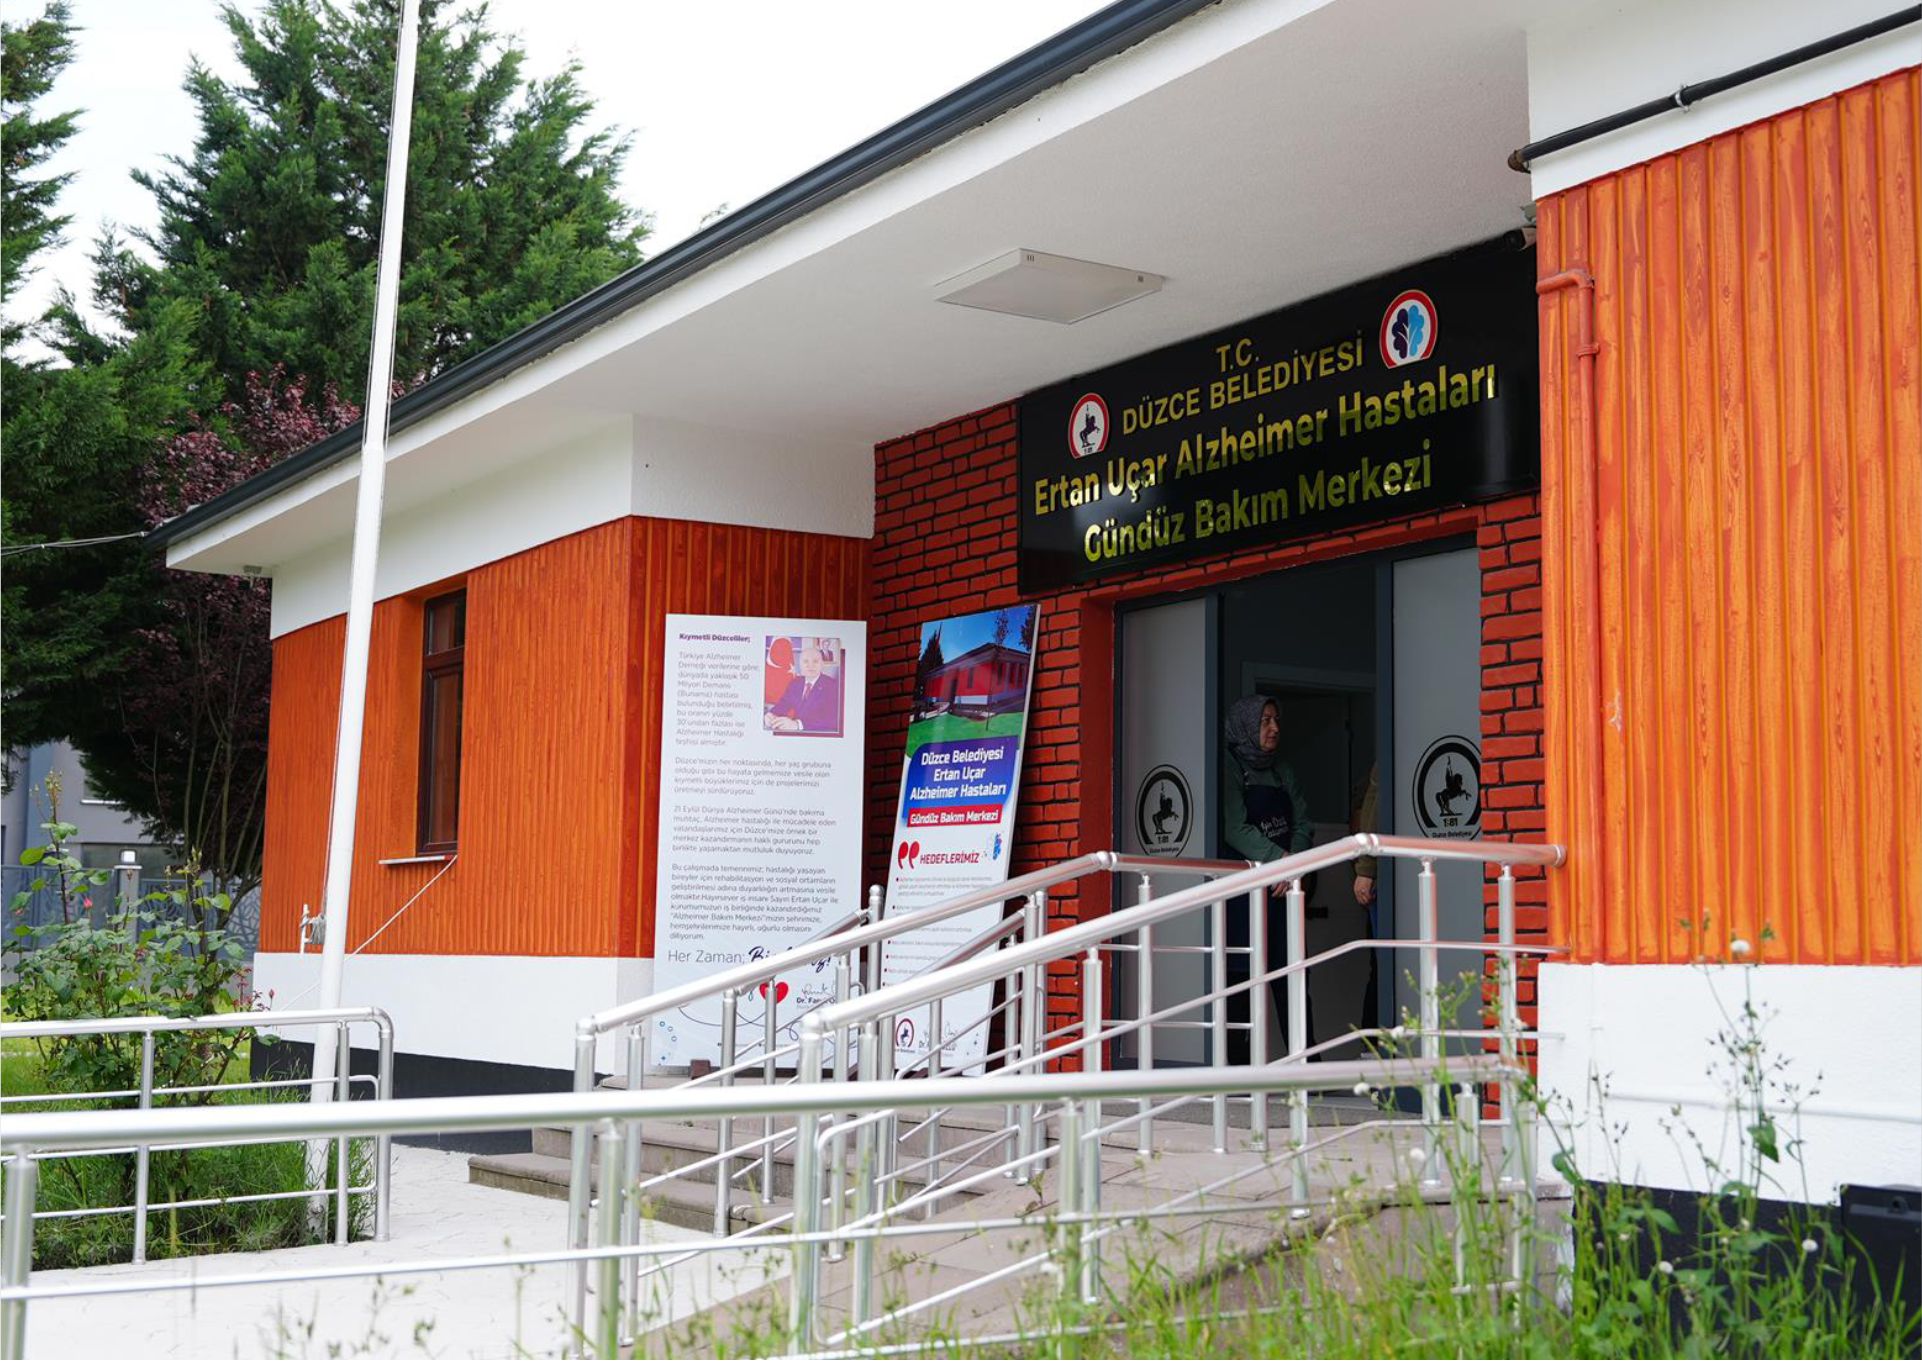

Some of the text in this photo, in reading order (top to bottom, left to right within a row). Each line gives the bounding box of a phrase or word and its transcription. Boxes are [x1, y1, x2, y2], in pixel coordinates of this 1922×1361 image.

[1216, 338, 1259, 373] T.C.
[1122, 329, 1363, 435] DÜZCE BELEDİYESİ
[1035, 363, 1497, 516] Ertan Uçar Alzheimer Hastaları
[1084, 439, 1432, 562] Gündüz Bakım Merkezi
[679, 633, 751, 643] Kıymetli Düzceliler;
[921, 746, 1004, 766] Düzce Belediyesi
[934, 766, 986, 782] Ertan Uçar
[910, 782, 1007, 800] Alzheimer Hastaları
[910, 809, 998, 824] Gündüz Bakım Merkezi
[920, 850, 980, 864] HEDEFLERİMİZ
[668, 950, 690, 962] Her
[696, 950, 745, 965] Zaman;
